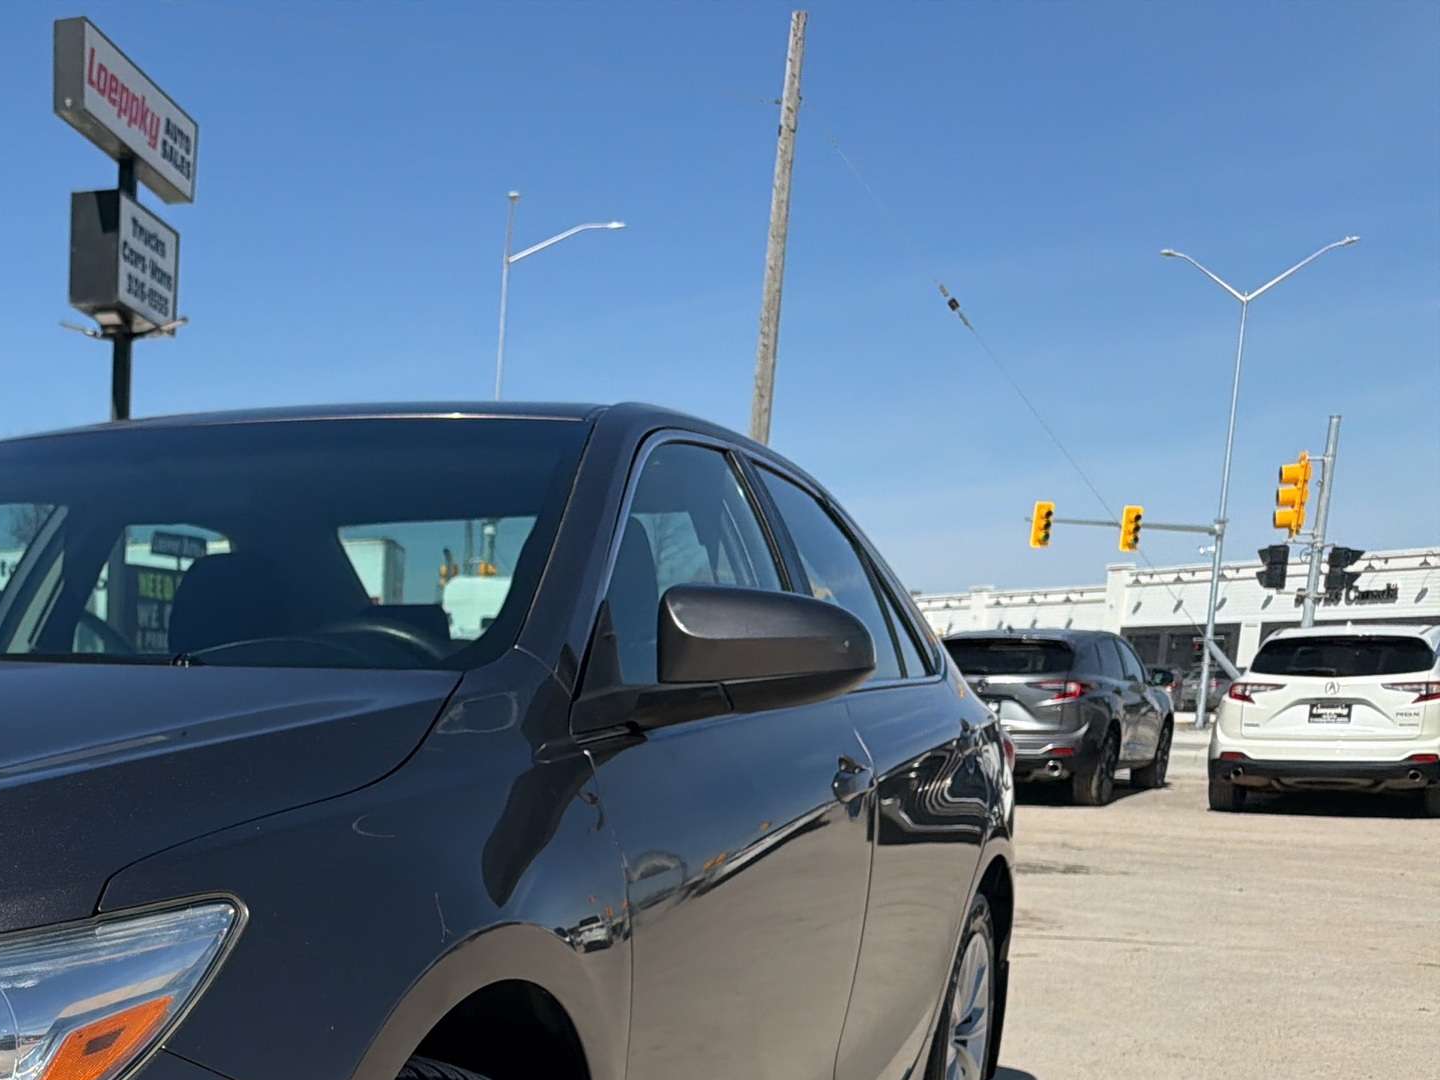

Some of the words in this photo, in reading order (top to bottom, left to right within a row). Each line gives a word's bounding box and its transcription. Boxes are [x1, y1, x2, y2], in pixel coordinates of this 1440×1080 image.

[88, 48, 160, 149] Loeppky
[165, 117, 191, 155] AUTO
[162, 139, 191, 180] SALES
[132, 216, 166, 259] Trucks
